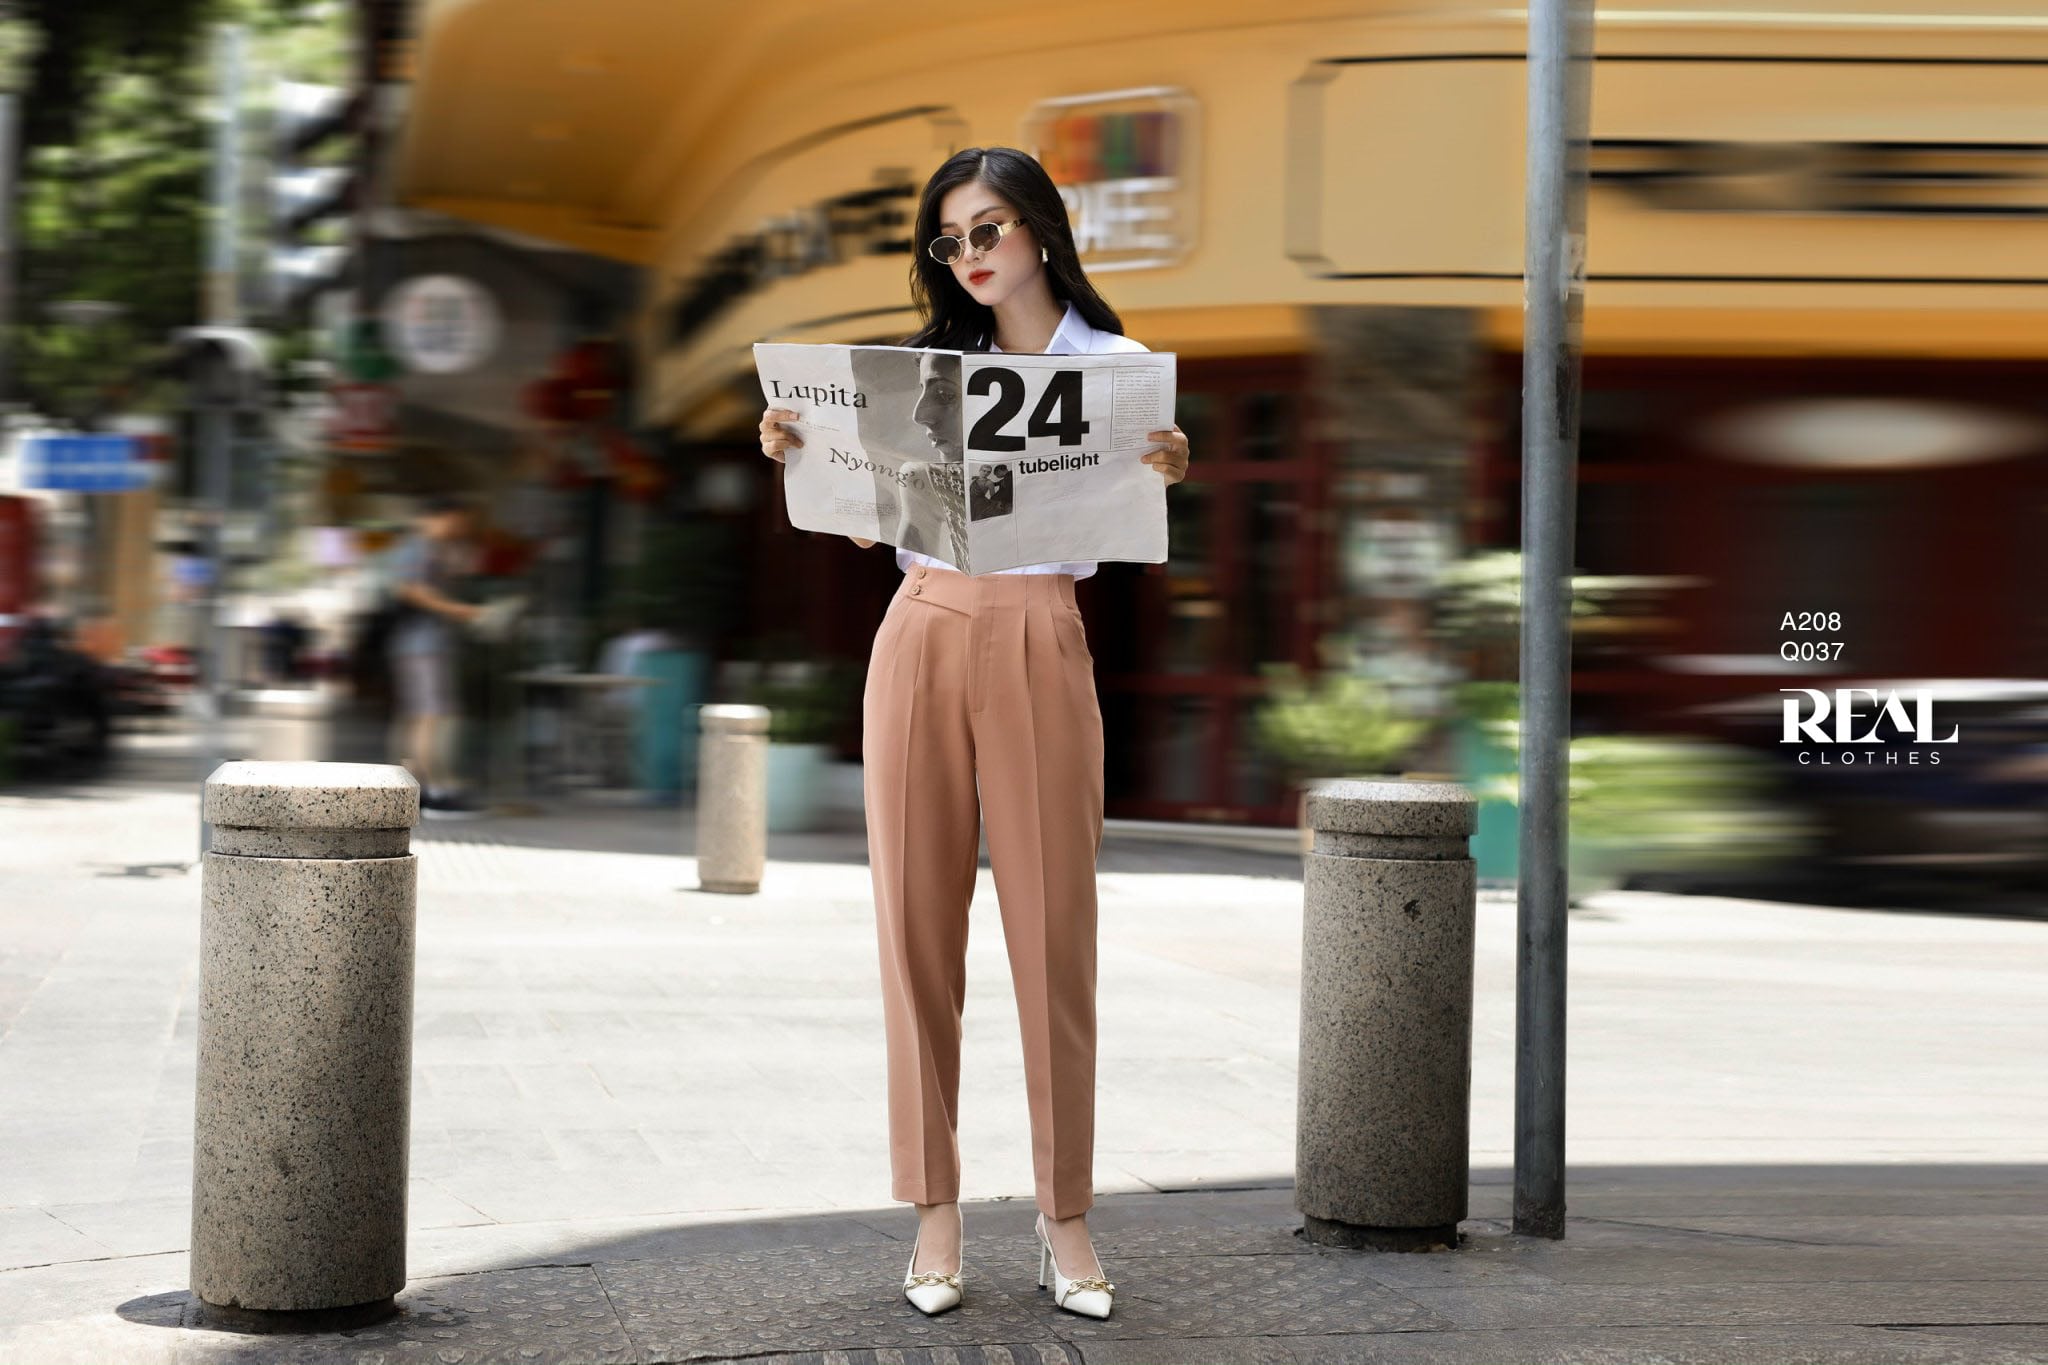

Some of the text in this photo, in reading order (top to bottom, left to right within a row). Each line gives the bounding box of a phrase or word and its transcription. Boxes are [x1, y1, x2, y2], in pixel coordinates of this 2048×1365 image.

[769, 380, 869, 409] Lupita
[966, 366, 1091, 453] 24
[1018, 452, 1100, 475] tubelight
